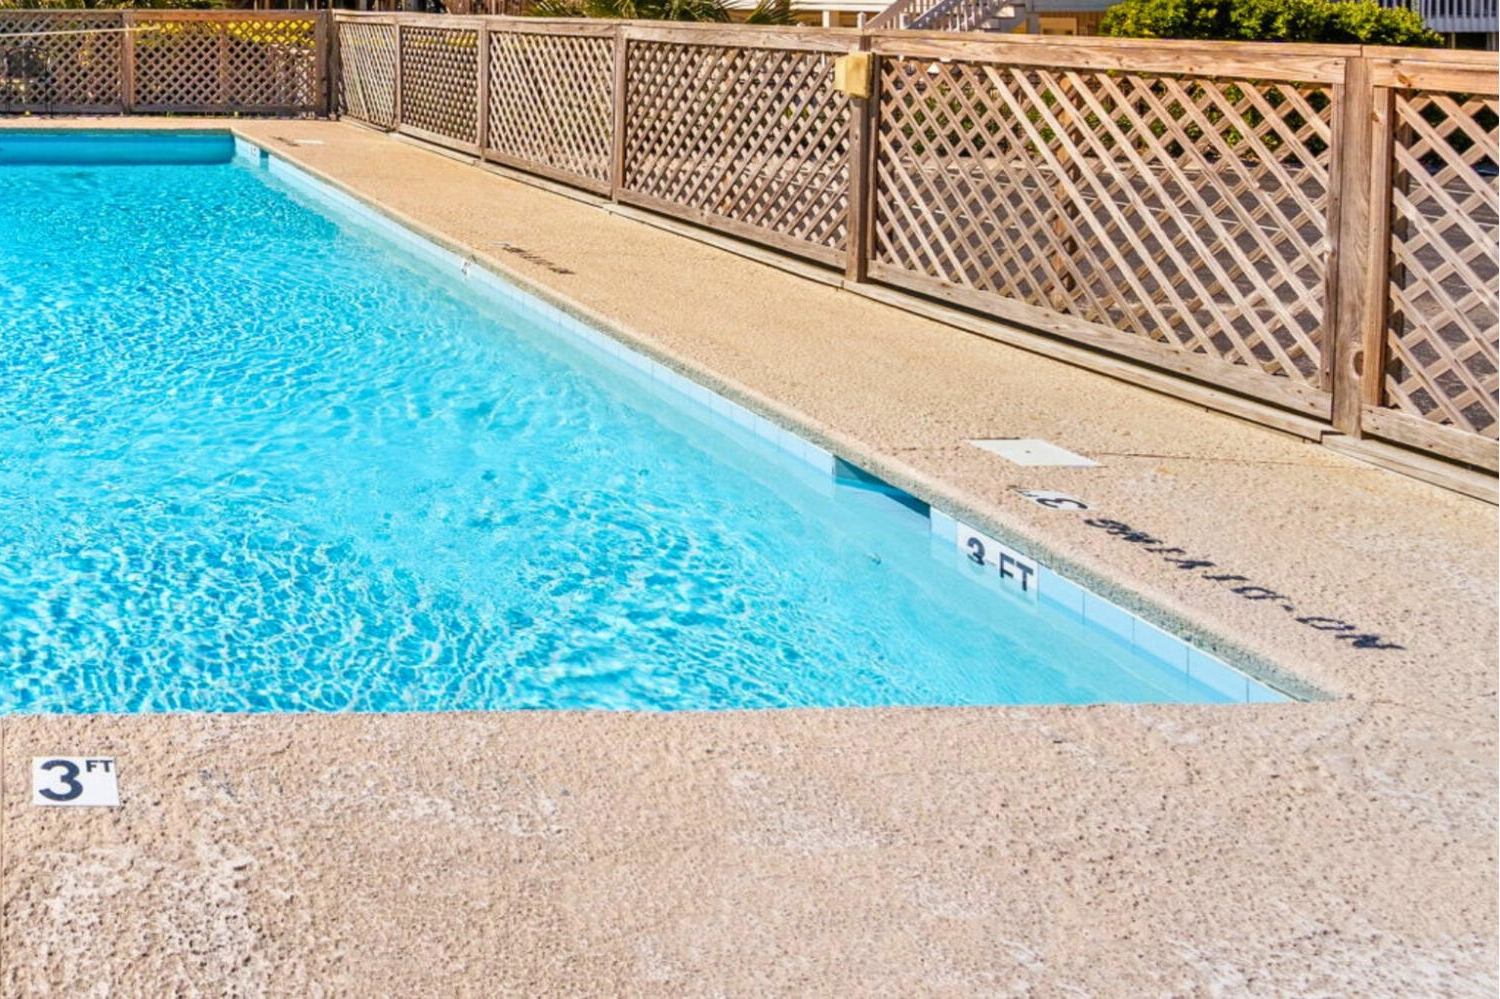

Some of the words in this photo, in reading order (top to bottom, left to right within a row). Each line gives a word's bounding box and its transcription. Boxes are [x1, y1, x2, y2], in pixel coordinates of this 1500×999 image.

[967, 537, 985, 566] 3
[999, 552, 1034, 592] FT
[38, 759, 84, 802] 3
[85, 759, 114, 773] FT
